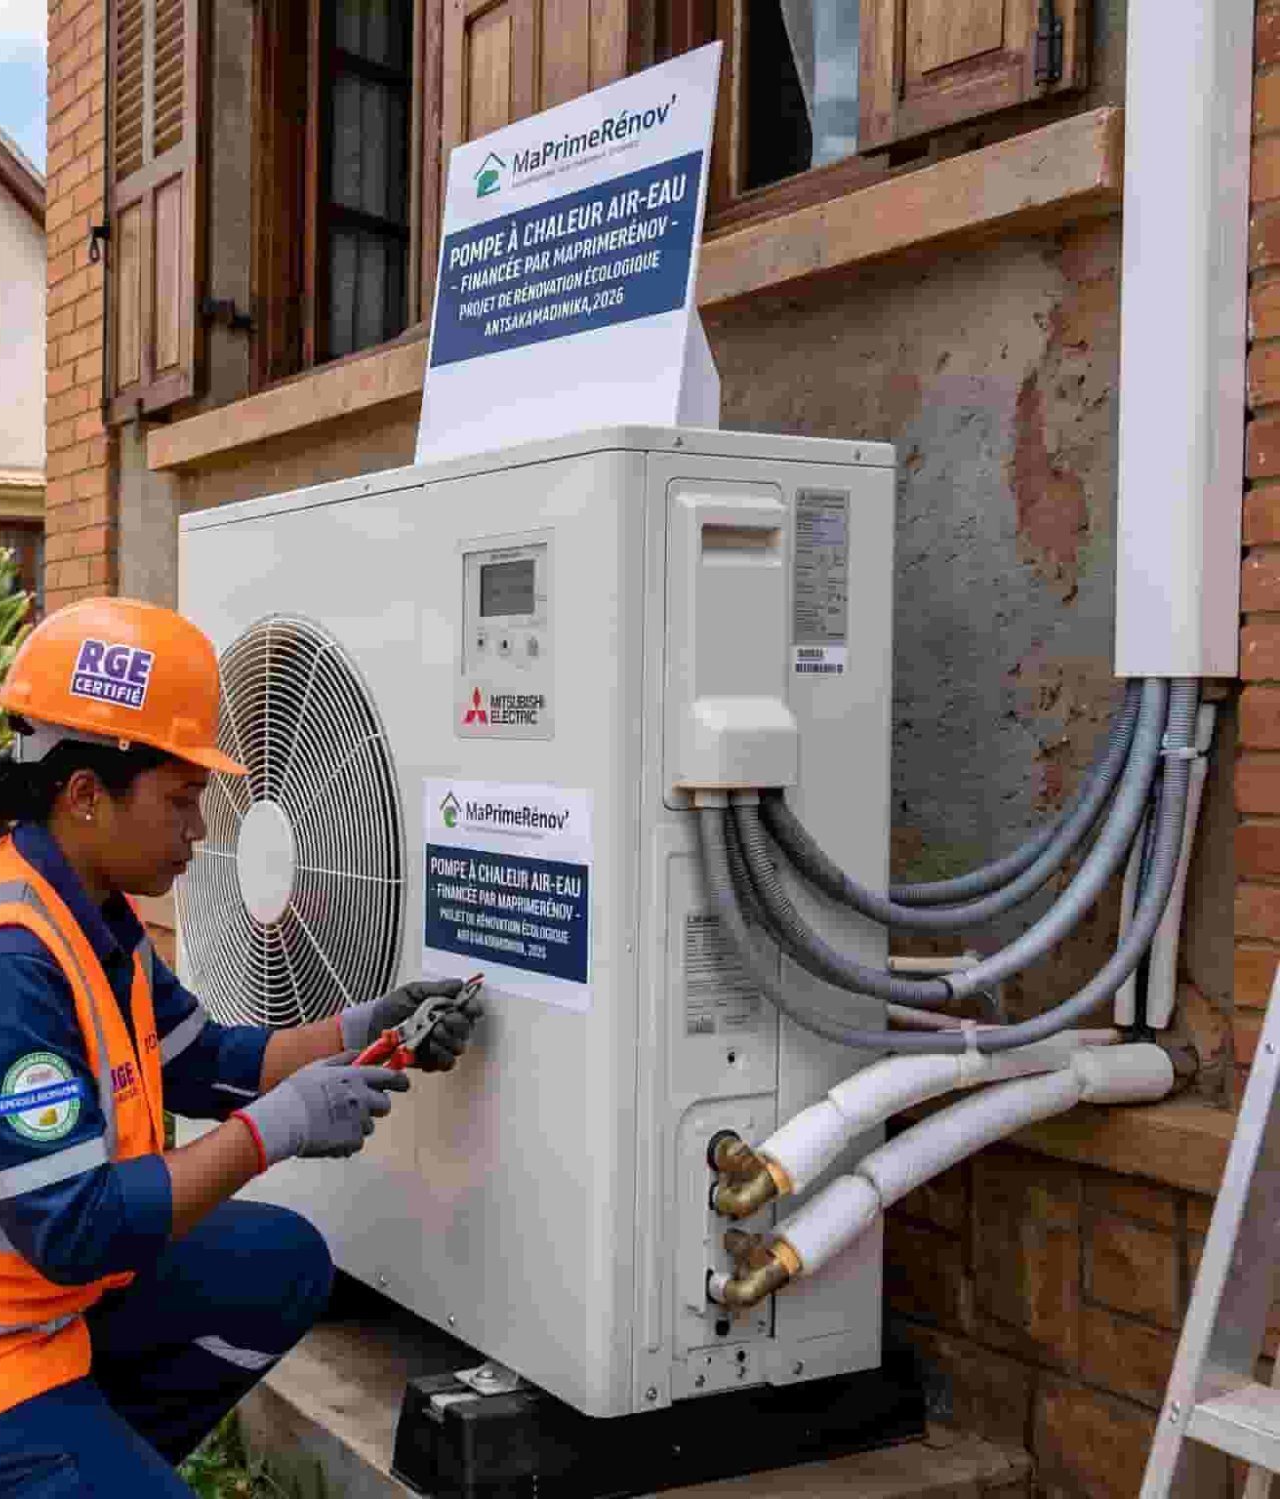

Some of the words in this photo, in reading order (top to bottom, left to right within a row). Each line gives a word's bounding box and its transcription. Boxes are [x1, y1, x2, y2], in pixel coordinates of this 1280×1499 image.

[449, 232, 505, 270] POMPE
[507, 221, 520, 251] À
[523, 200, 604, 247] CHALEUR
[607, 174, 687, 222] AIR-EAU
[460, 256, 521, 293] FINANCÉE
[524, 251, 550, 274] PAR
[553, 216, 669, 266] MAPRIMERÉNOV
[459, 297, 496, 321] PROJET
[498, 291, 515, 309] DE
[513, 272, 582, 304] RÉNOVATION
[584, 249, 661, 287] ÉCOLOGIQUE
[78, 639, 153, 685] RGE
[74, 675, 143, 703] CERTIFIÉ
[490, 694, 545, 710] MITSUBISHI
[491, 710, 538, 725] ELECTRIC
[431, 857, 469, 880] POMPE
[468, 858, 476, 882] À
[478, 864, 530, 890] CHALEUR
[530, 872, 582, 897] AIR-EAU
[479, 890, 497, 906] PAR
[498, 892, 573, 922] MAPRIMERÉNOV
